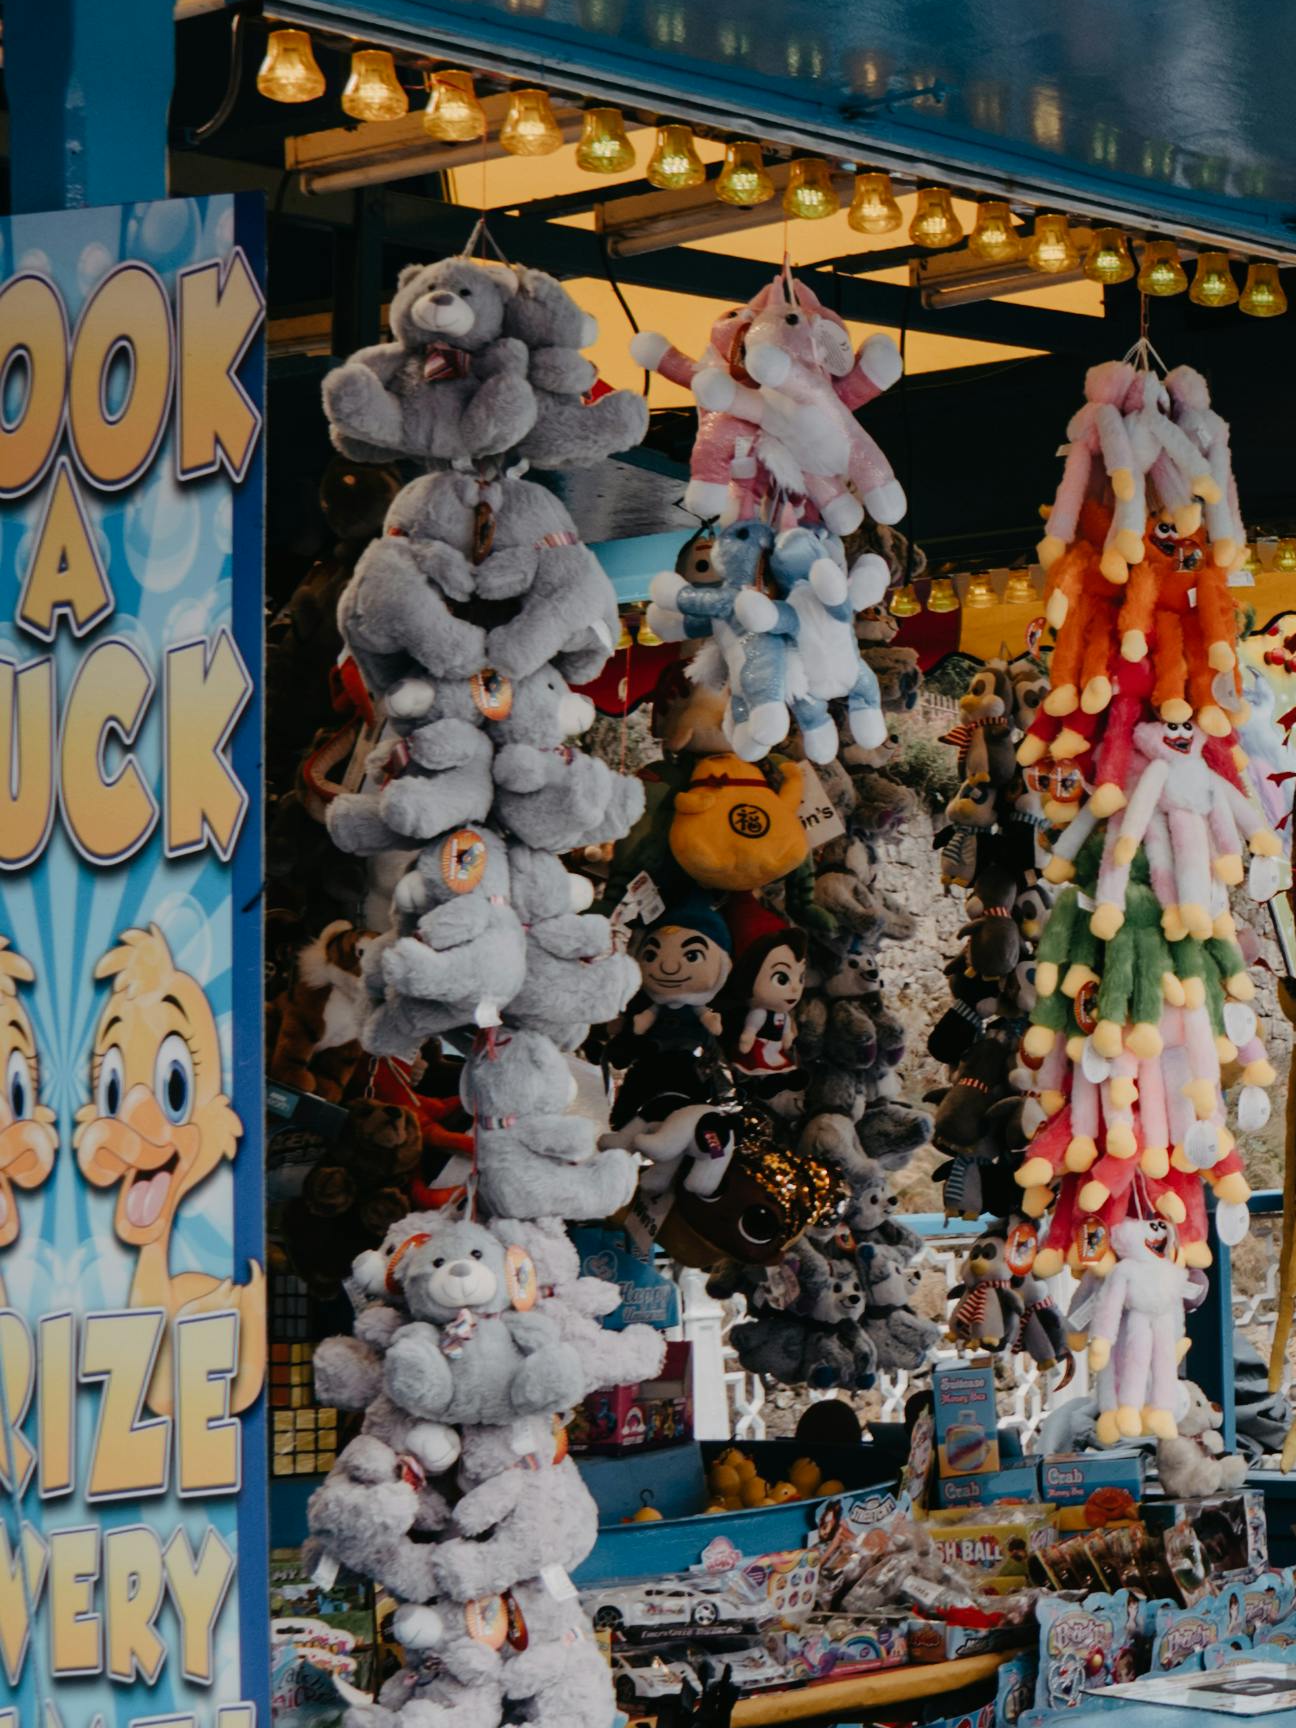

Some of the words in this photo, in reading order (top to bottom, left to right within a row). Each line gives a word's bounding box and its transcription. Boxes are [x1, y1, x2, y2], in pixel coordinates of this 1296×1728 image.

[15, 457, 114, 643] A
[735, 808, 763, 833] 福
[1046, 1466, 1084, 1485] Crab
[943, 1482, 981, 1500] Crab
[961, 1538, 1003, 1562] BALL
